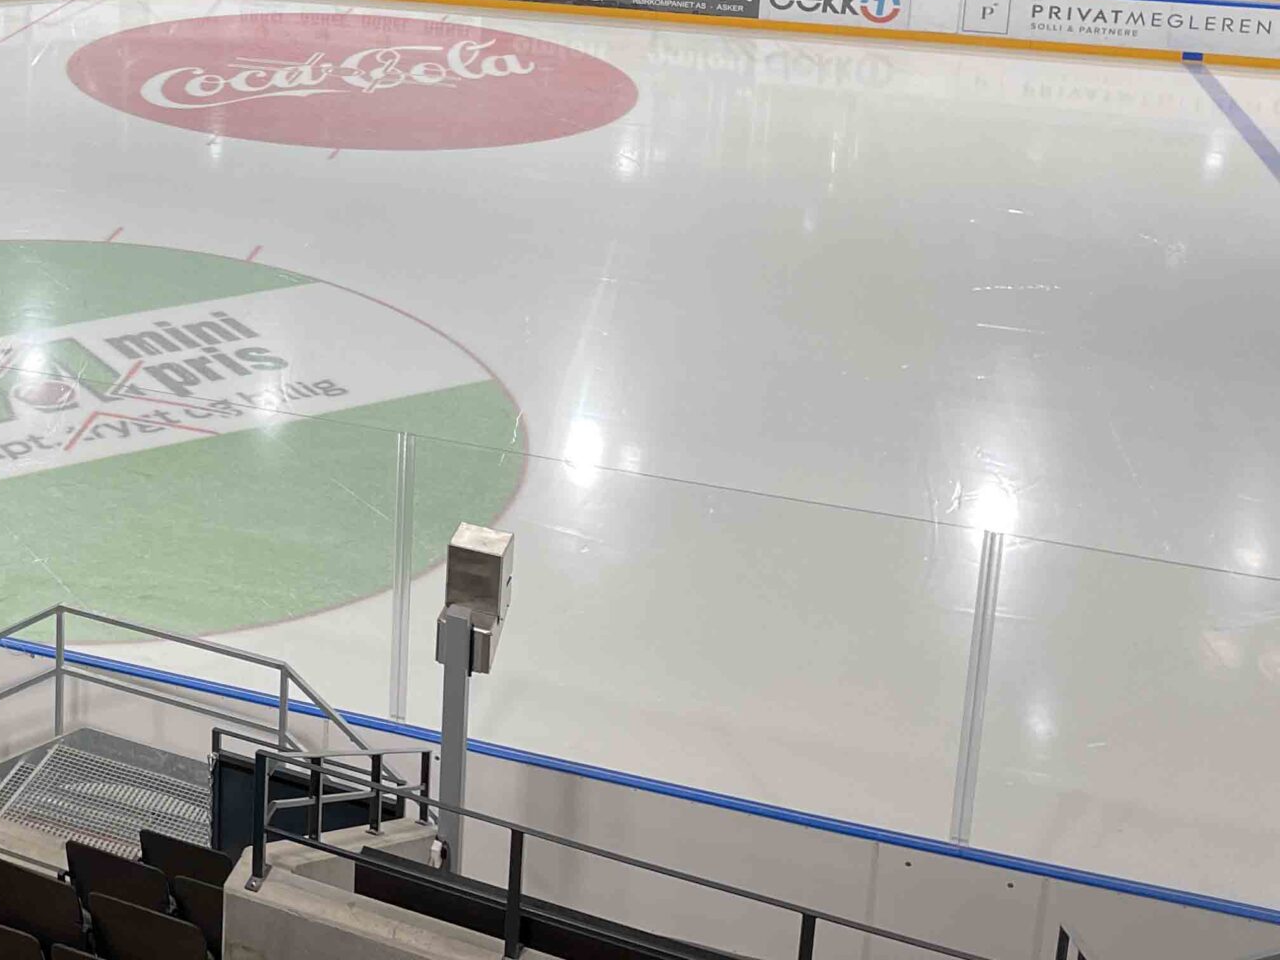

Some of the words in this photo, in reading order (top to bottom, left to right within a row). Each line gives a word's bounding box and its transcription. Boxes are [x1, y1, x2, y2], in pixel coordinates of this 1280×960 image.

[695, 1, 707, 10] AS
[716, 3, 744, 12] ASKER
[1030, 4, 1273, 36] PRIVATMEGLEREN
[1030, 22, 1063, 32] SOLLI
[1078, 25, 1139, 37] PARTNERE
[103, 311, 261, 360] mini
[143, 346, 290, 397] pris
[236, 377, 349, 403] bllig
